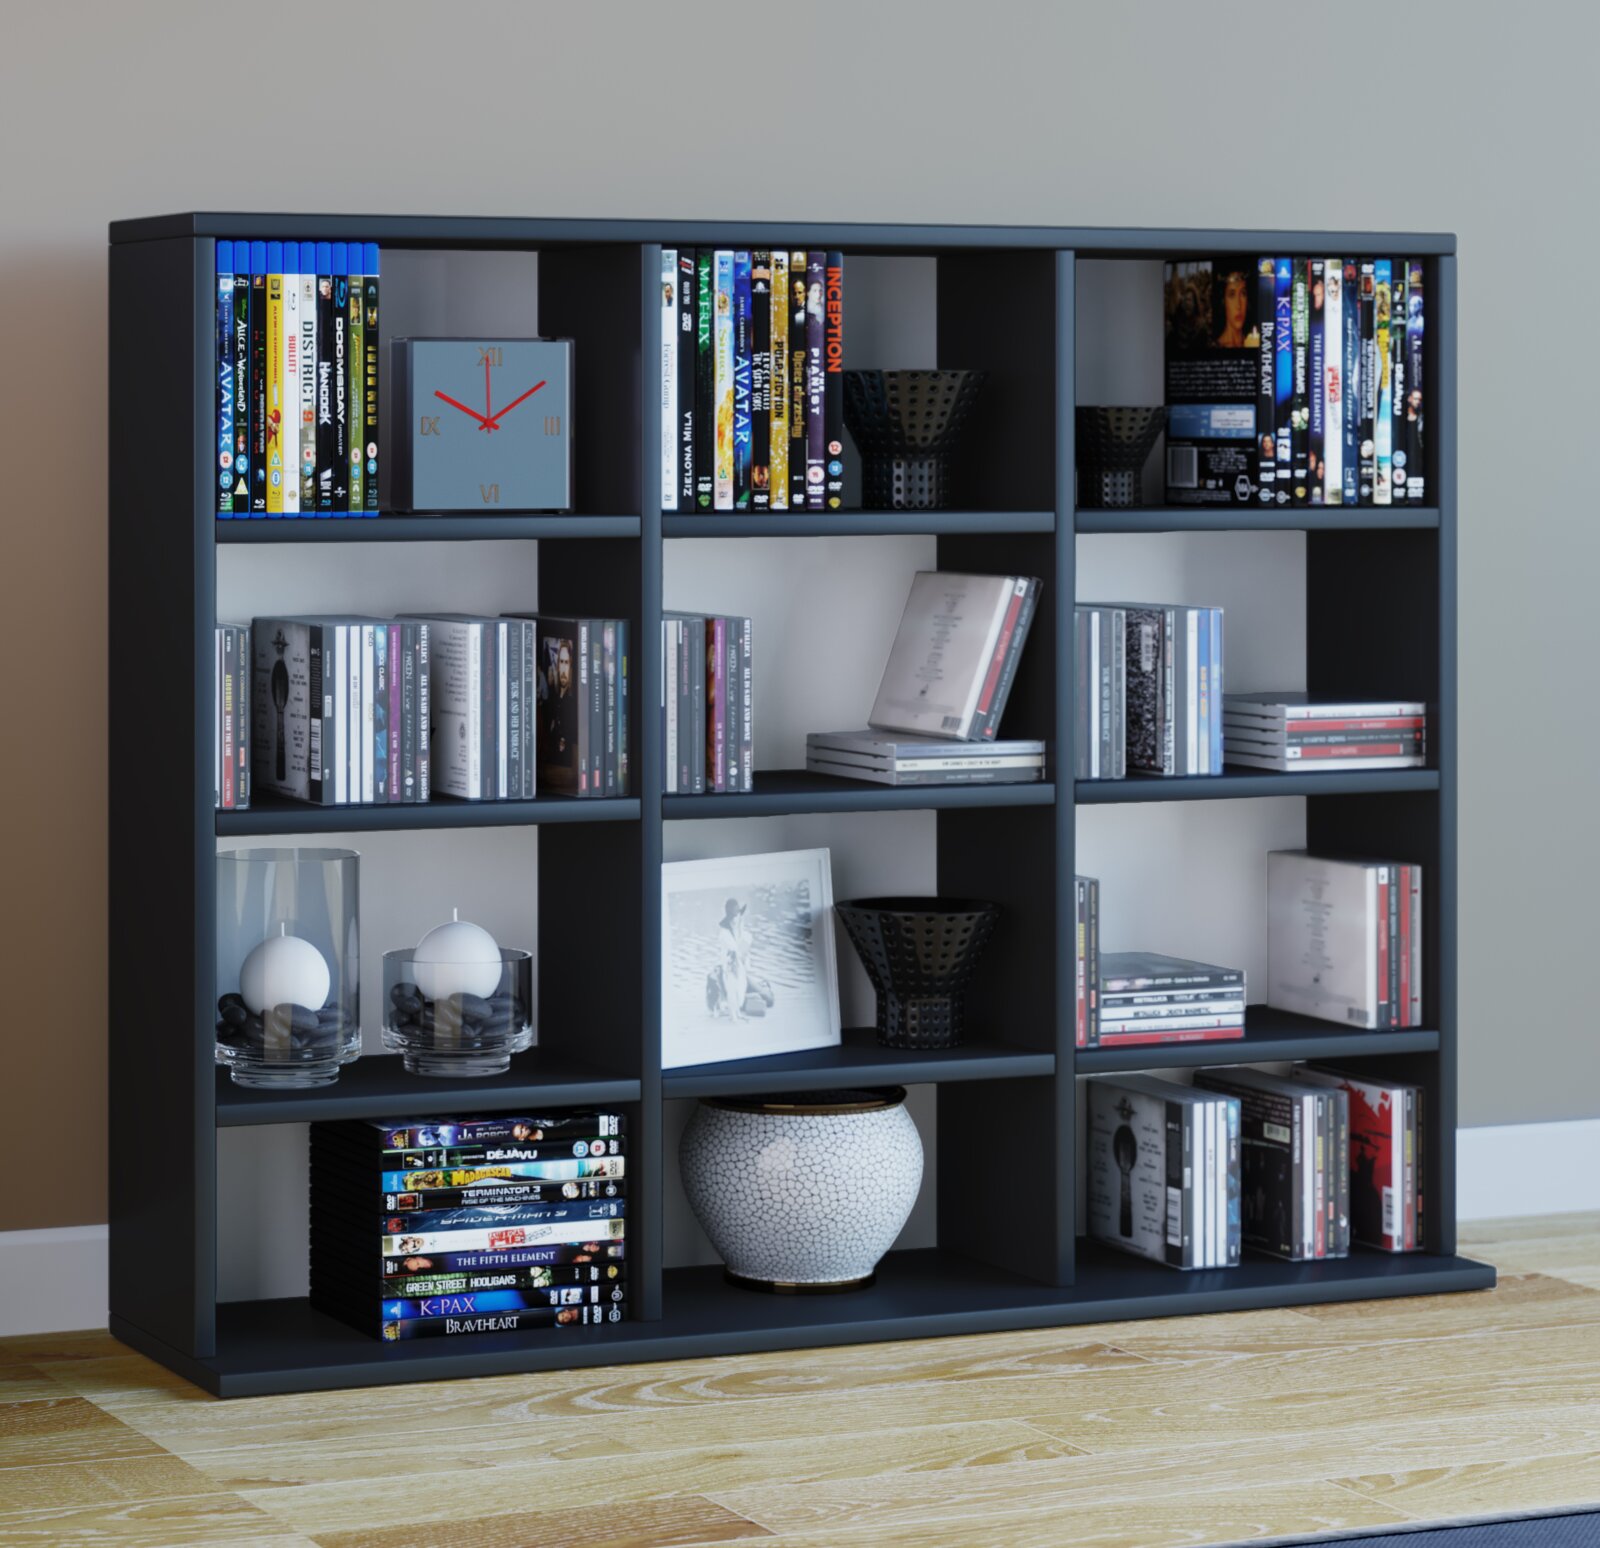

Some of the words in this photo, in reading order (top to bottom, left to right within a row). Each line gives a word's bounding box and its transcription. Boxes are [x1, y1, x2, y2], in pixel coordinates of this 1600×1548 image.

[698, 267, 710, 345] MATRIX
[827, 266, 842, 373] INCEPTION
[1277, 296, 1291, 352] K-PAX
[288, 335, 297, 373] BULLITT
[477, 347, 503, 367] XII
[774, 341, 784, 369] PULP
[1261, 322, 1274, 396] BRAVEHEART
[1314, 334, 1322, 354] THE
[303, 320, 314, 405] DISTRICT
[336, 317, 344, 424] DOOMSDAY
[1314, 355, 1322, 385] FIFTH
[319, 361, 332, 425] HANCOCK
[774, 373, 784, 419] FICTION
[811, 347, 820, 415] PIANIST
[220, 361, 232, 448] AVATAR
[735, 355, 750, 446] AVATAR
[1313, 388, 1322, 434] ELEMENT
[420, 416, 441, 436] IX
[543, 416, 561, 436] III
[683, 411, 692, 441] MILA
[683, 445, 692, 497] ZIELONA
[479, 484, 500, 503] VI
[452, 1167, 512, 1186] MADAGASCAR
[461, 1187, 527, 1198] TERMINATOR
[532, 1186, 541, 1194] 3
[457, 1258, 477, 1267] THE
[479, 1256, 508, 1265] FIFTH
[511, 1252, 556, 1263] ELEMENT
[406, 1281, 434, 1293] GREEN
[435, 1279, 467, 1291] STREET
[470, 1275, 517, 1288] HOOLIGANS
[420, 1297, 477, 1316] K-PAX
[446, 1316, 520, 1334] BRAVEHEART
